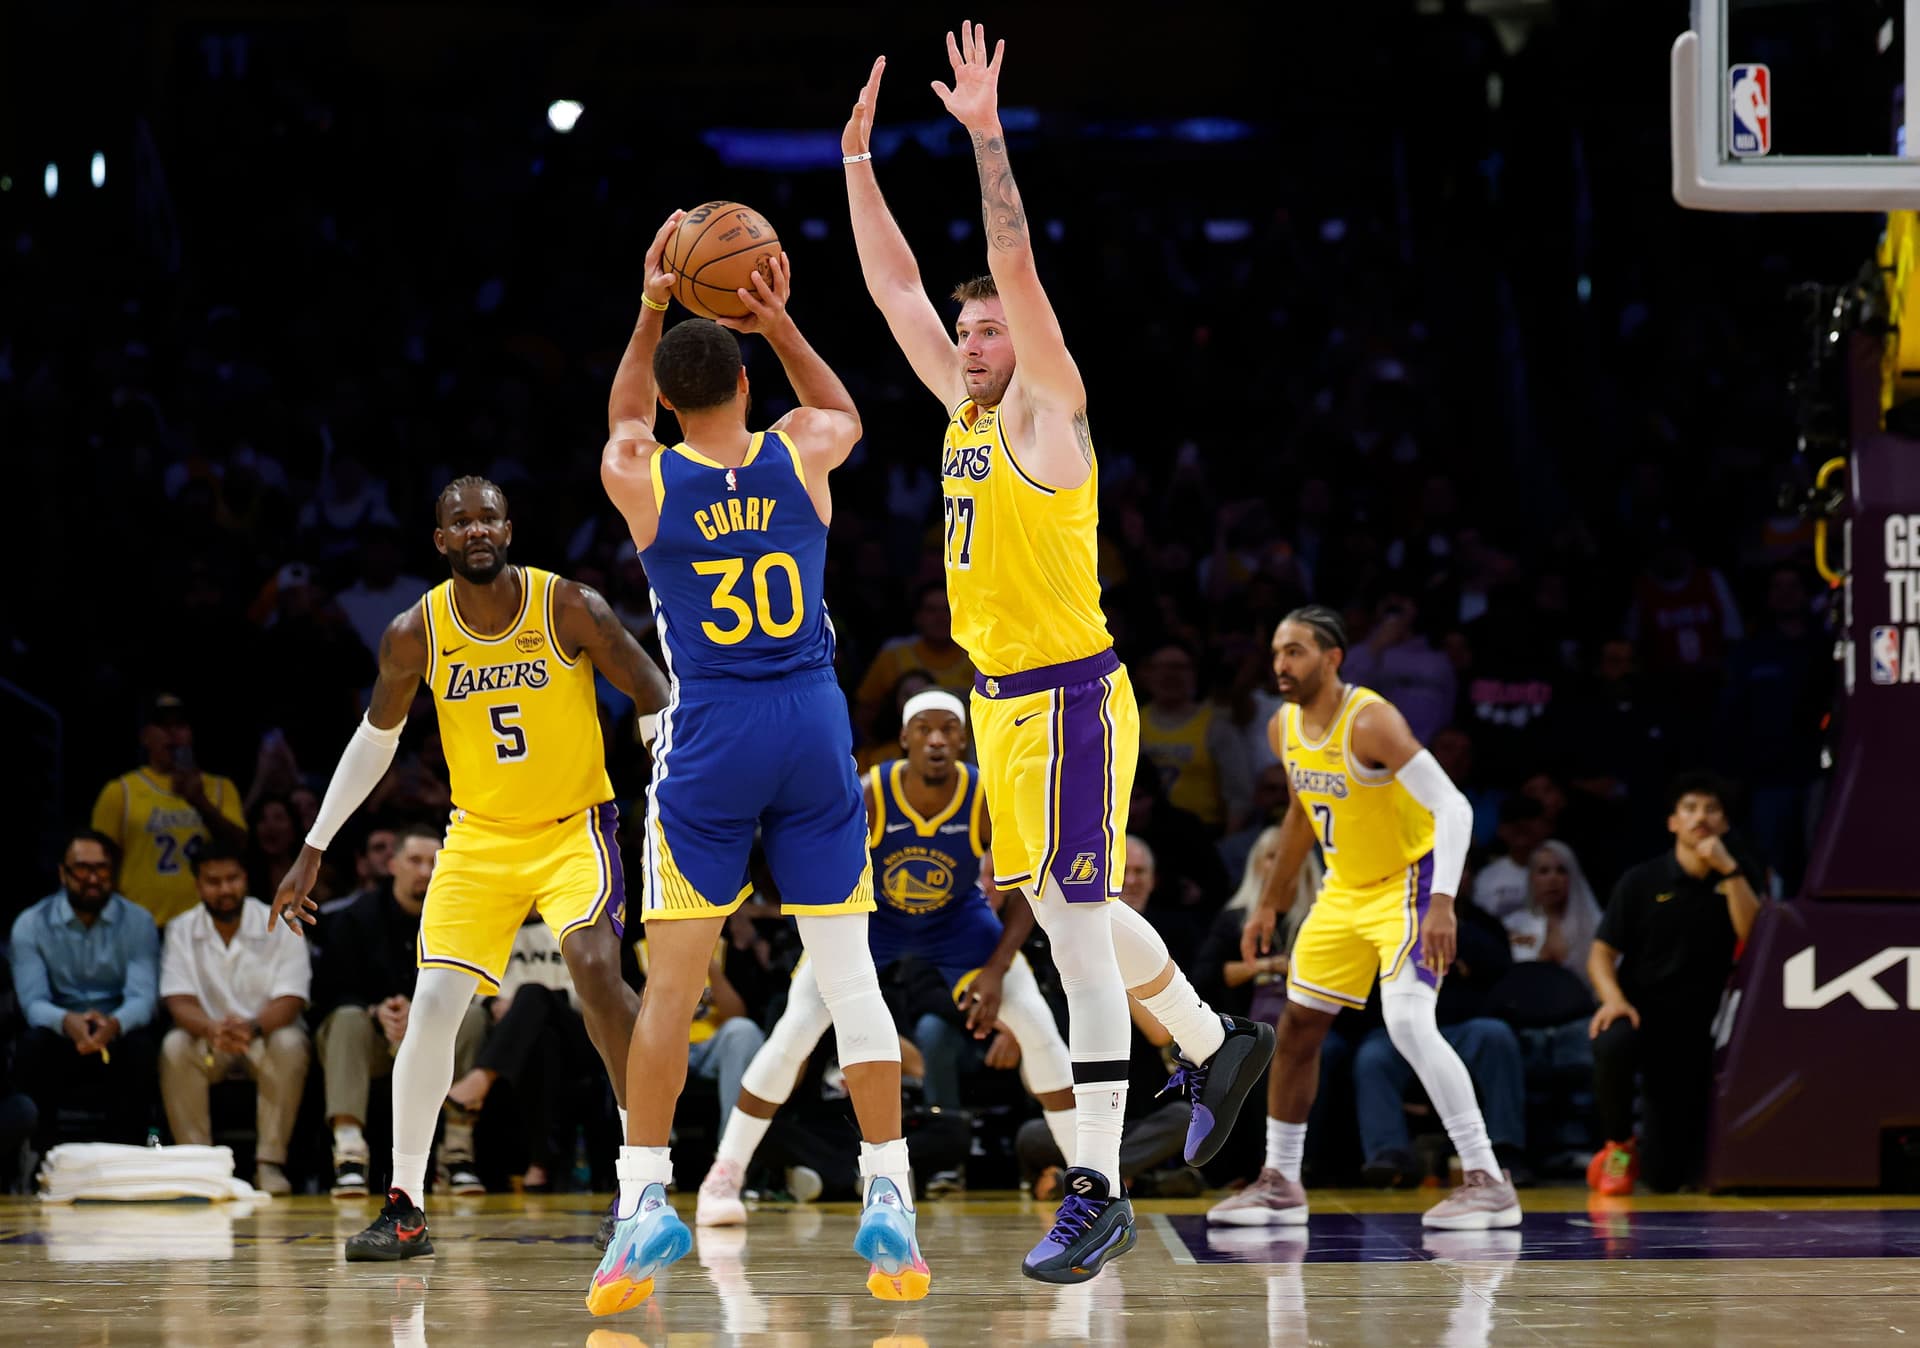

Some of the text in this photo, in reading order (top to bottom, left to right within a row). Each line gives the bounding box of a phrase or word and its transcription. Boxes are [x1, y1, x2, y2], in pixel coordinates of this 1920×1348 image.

[693, 496, 777, 541] CURRY
[943, 496, 975, 570] 77
[691, 552, 804, 646] 30
[517, 635, 544, 646] bibigo
[443, 658, 550, 701] LAKERS
[488, 703, 529, 763] 5
[1288, 761, 1349, 799] LAKERS
[1310, 802, 1338, 853] 7
[925, 868, 946, 887] 10
